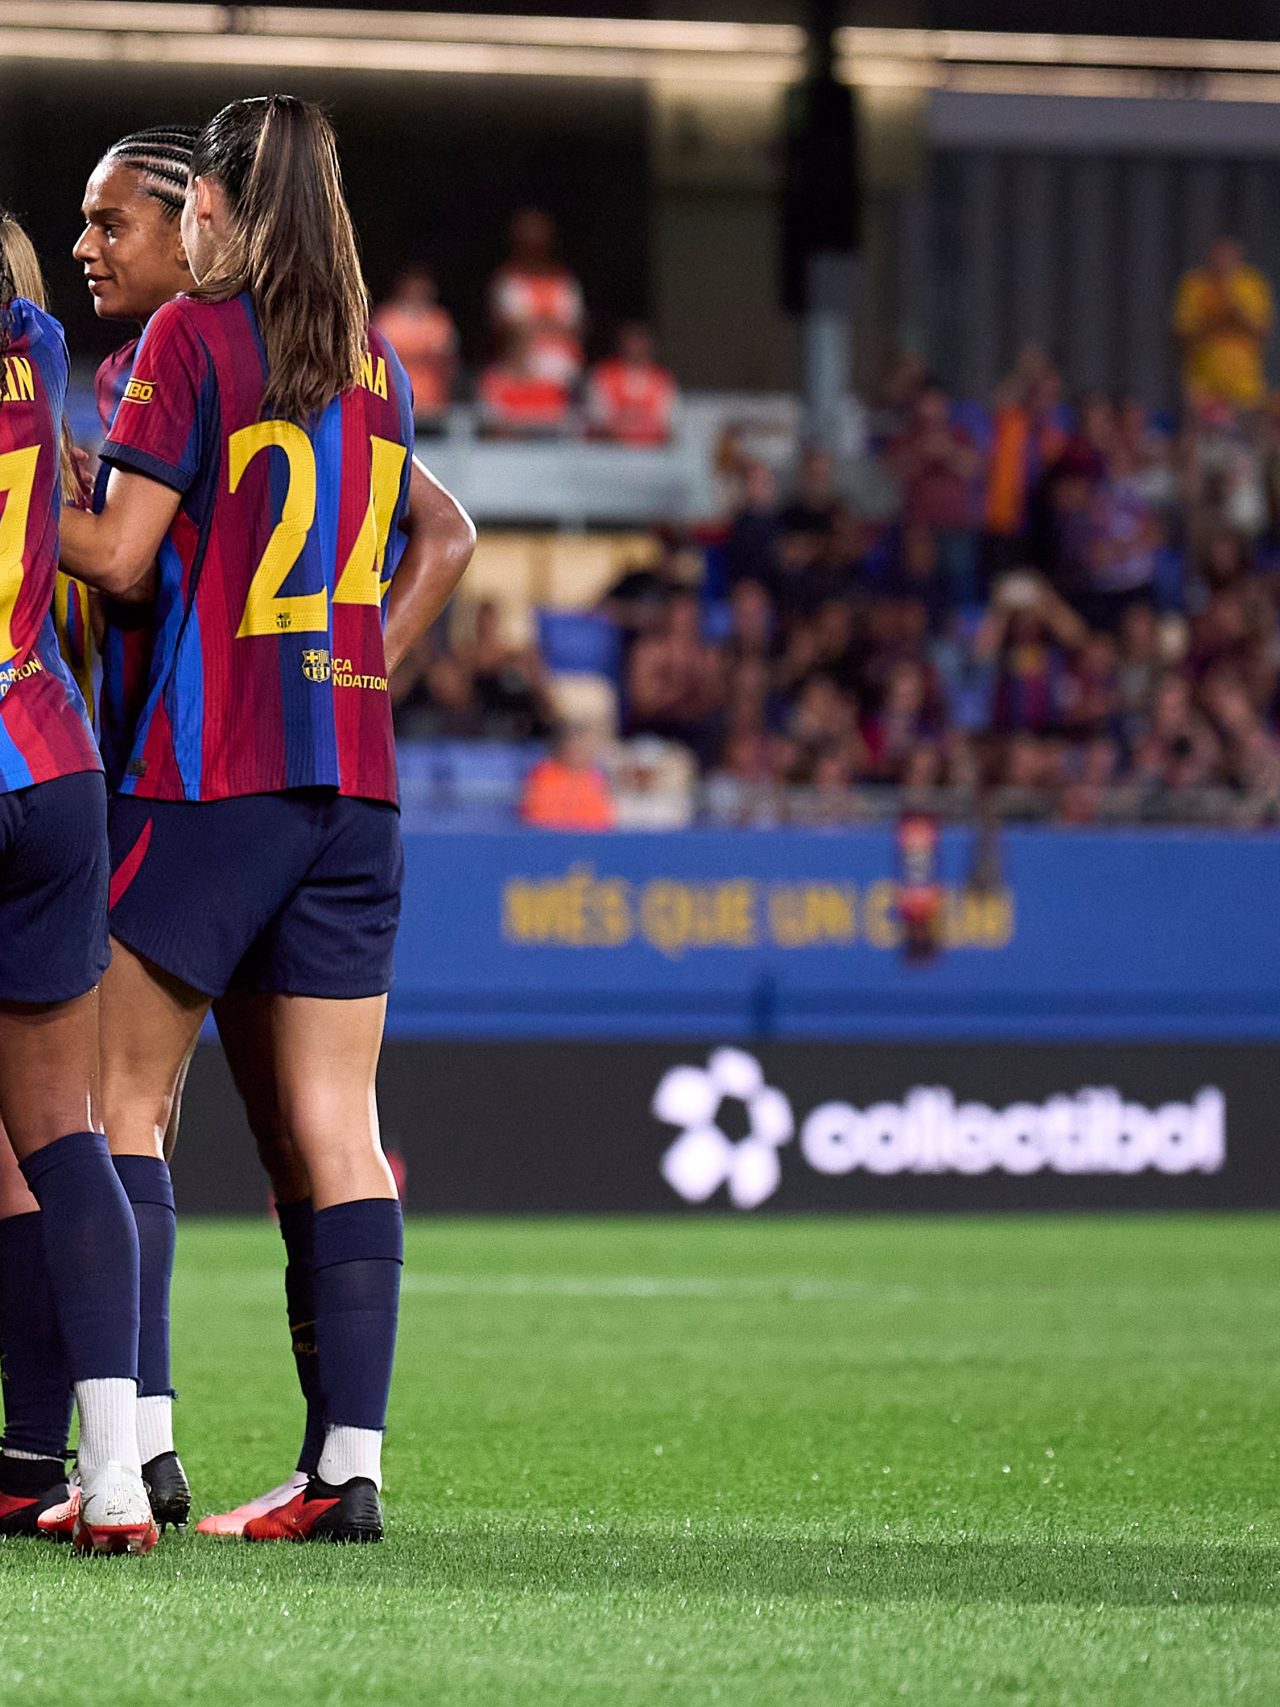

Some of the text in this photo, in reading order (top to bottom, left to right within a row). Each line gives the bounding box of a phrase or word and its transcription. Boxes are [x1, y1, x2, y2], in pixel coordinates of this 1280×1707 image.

[228, 419, 408, 638] 24
[333, 673, 388, 692] NDATION
[801, 1086, 1226, 1177] collectibol
